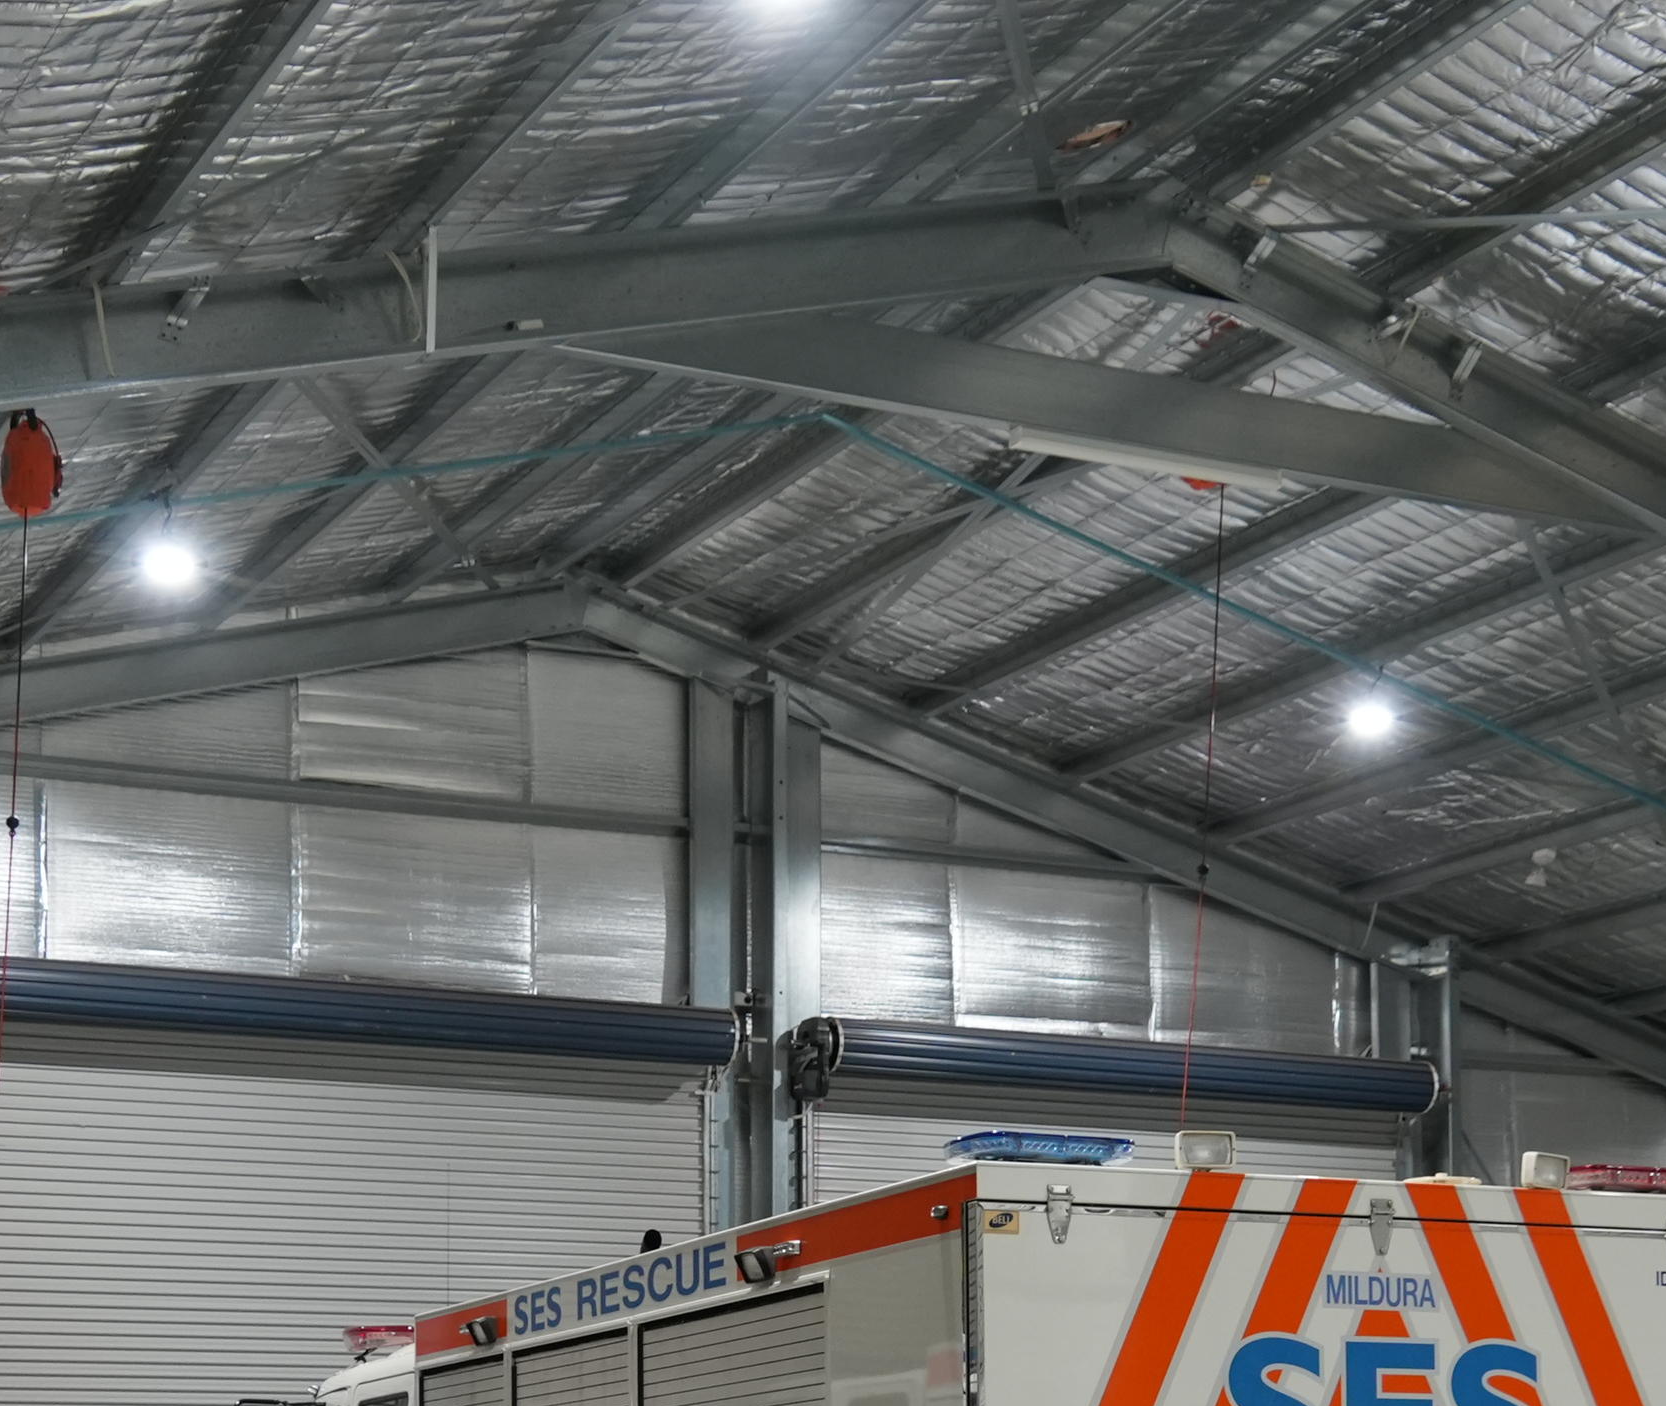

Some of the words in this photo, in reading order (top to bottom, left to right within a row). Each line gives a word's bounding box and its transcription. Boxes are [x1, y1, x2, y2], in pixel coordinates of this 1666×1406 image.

[514, 1286, 562, 1335] SES
[577, 1241, 727, 1321] RESCUE
[1326, 1274, 1436, 1308] MILDURA
